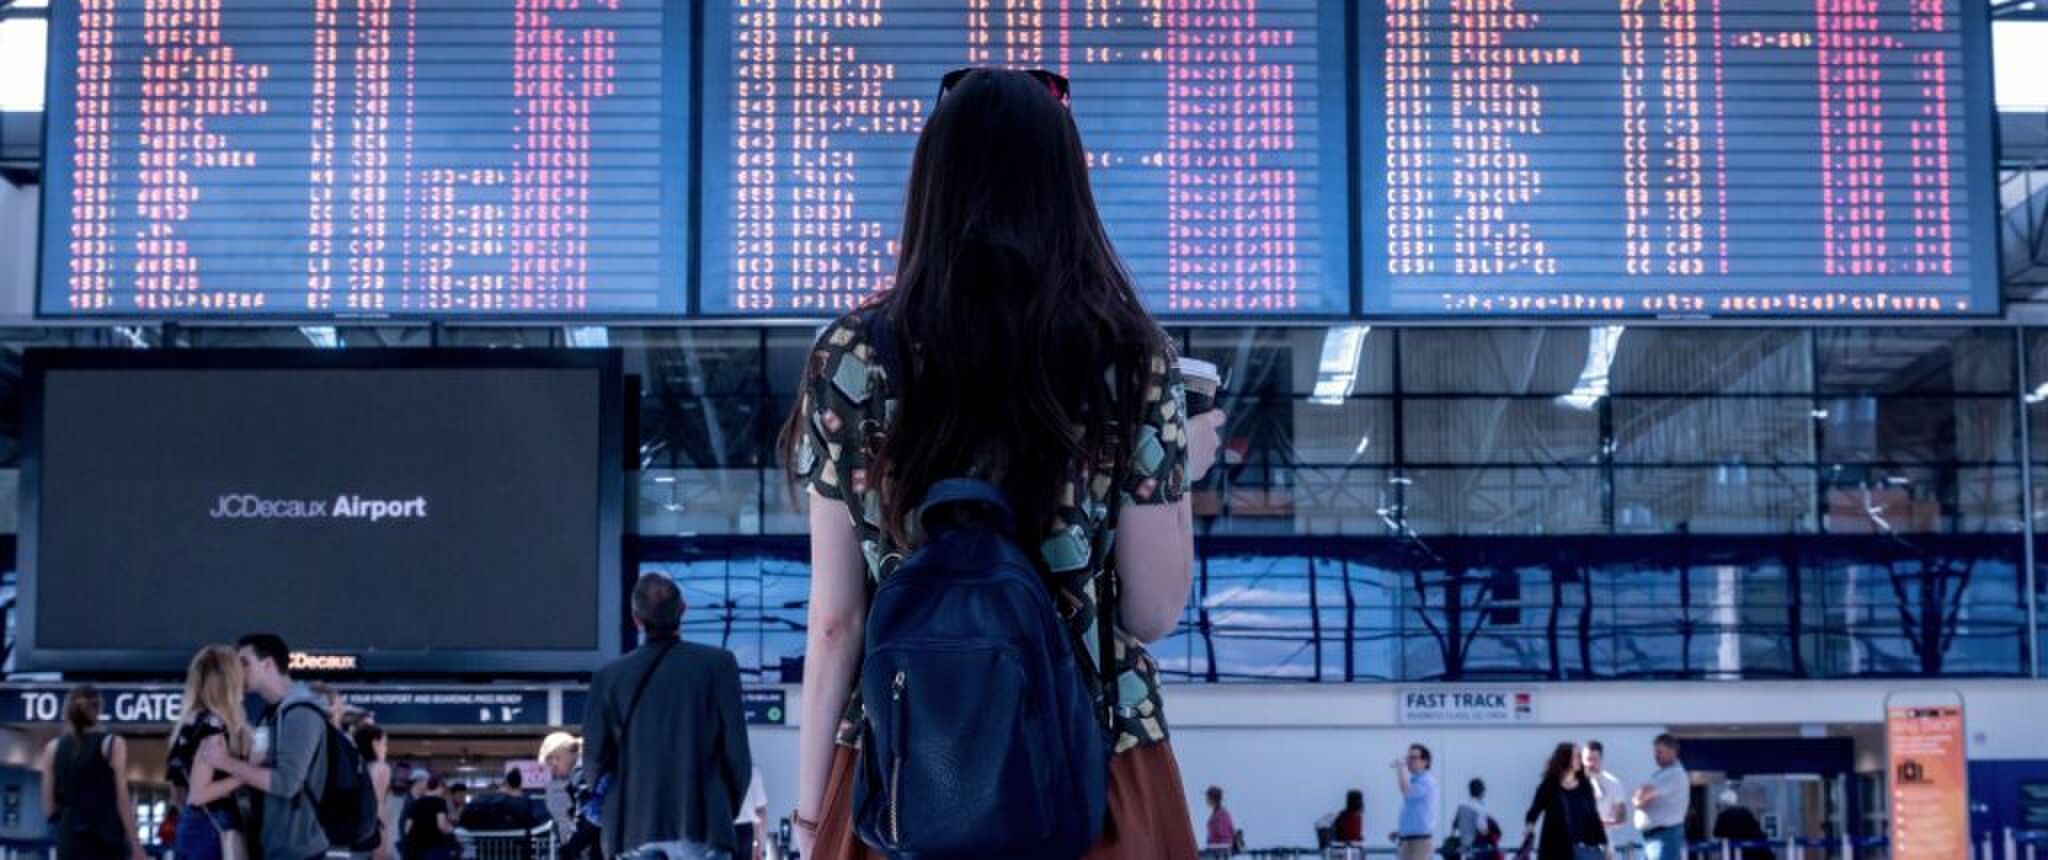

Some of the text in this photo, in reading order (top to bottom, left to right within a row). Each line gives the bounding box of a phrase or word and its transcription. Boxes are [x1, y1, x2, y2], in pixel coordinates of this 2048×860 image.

[209, 495, 427, 522] JCDecaux Airport
[288, 651, 356, 669] CDecaux
[20, 692, 58, 720] TO
[115, 692, 184, 721] GATE
[1407, 692, 1506, 708] FAST TRACK
